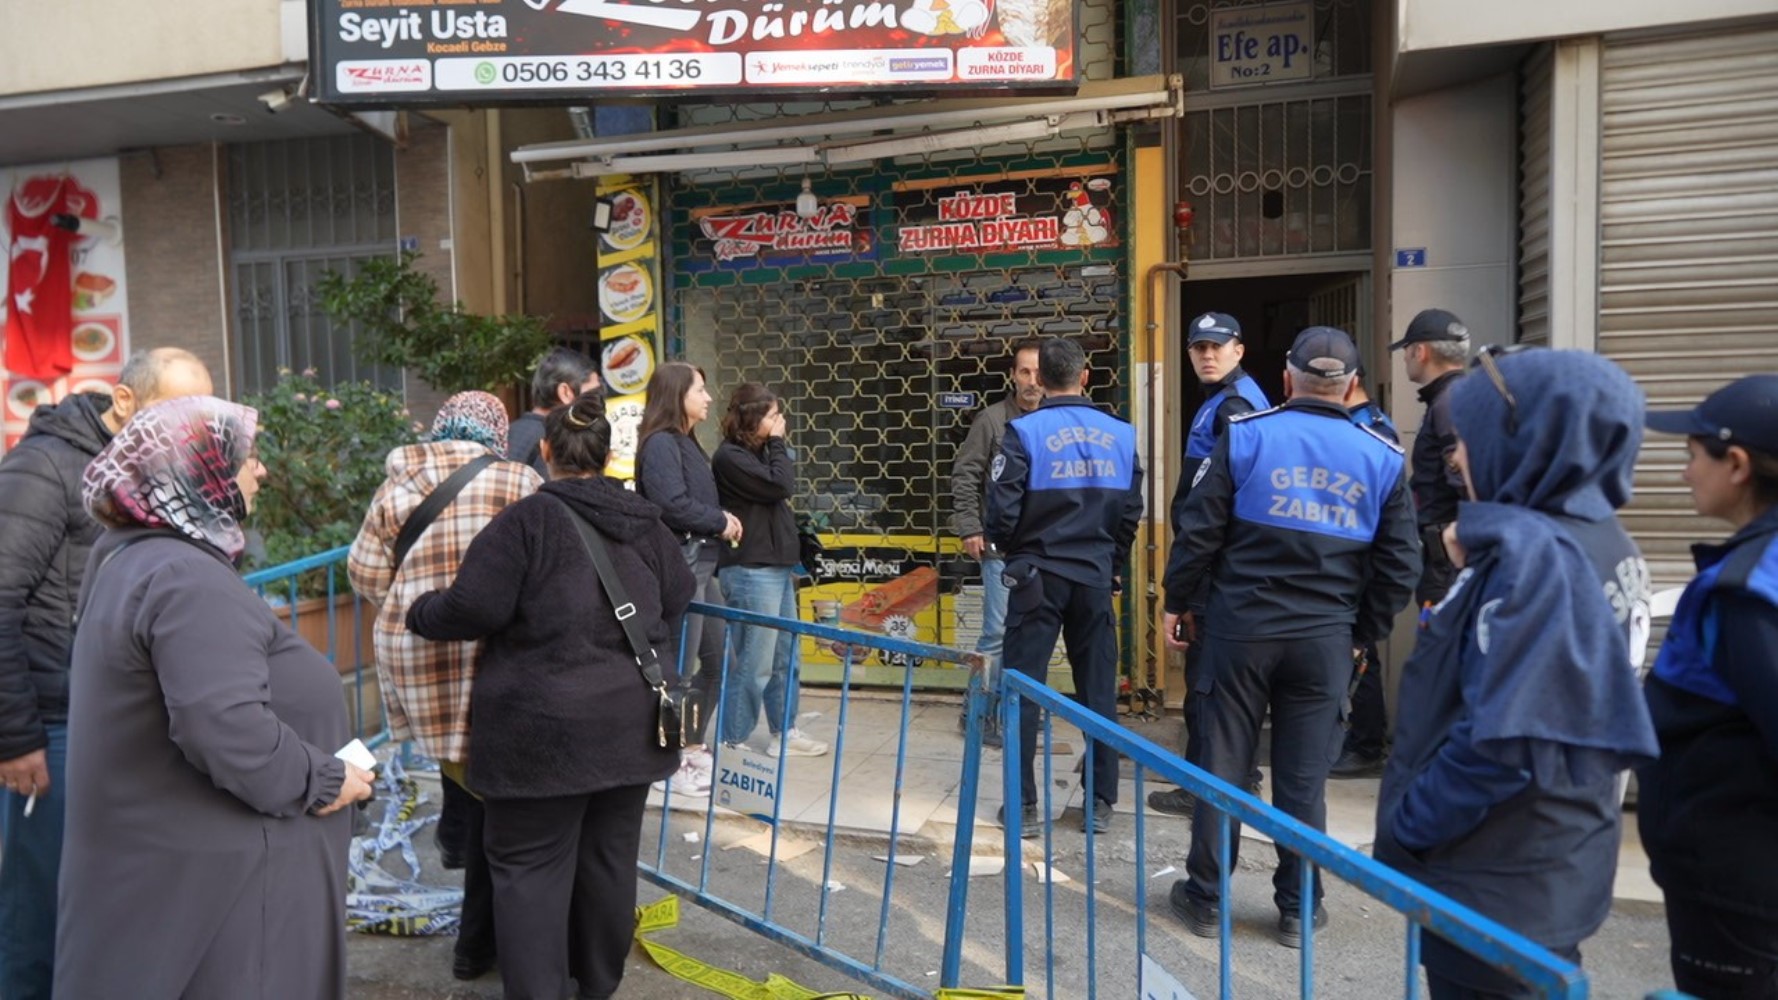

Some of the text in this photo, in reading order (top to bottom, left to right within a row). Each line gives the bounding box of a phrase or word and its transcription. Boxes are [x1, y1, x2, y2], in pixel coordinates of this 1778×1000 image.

[339, 9, 422, 48] Seyit
[431, 9, 507, 39] Usta
[706, 0, 898, 45] Dürüm
[427, 41, 507, 53] Kocaeli Gebze
[987, 51, 1024, 63] KÖZDE
[1217, 30, 1308, 68] Efe ap.
[502, 62, 568, 82] 0506
[576, 61, 626, 80] 343
[967, 62, 1045, 76] ZURNA DİYARI
[1231, 63, 1271, 79] No:2
[939, 191, 1015, 221] KÖZDE
[899, 217, 1058, 251] ZURNA DİYARI
[1406, 254, 1415, 266] 2
[1045, 426, 1115, 452] GEBZE
[1051, 459, 1116, 479] ZABITA
[1270, 466, 1367, 505] GEBZE
[1268, 495, 1359, 529] ZABITA
[719, 767, 774, 800] ZABITA
